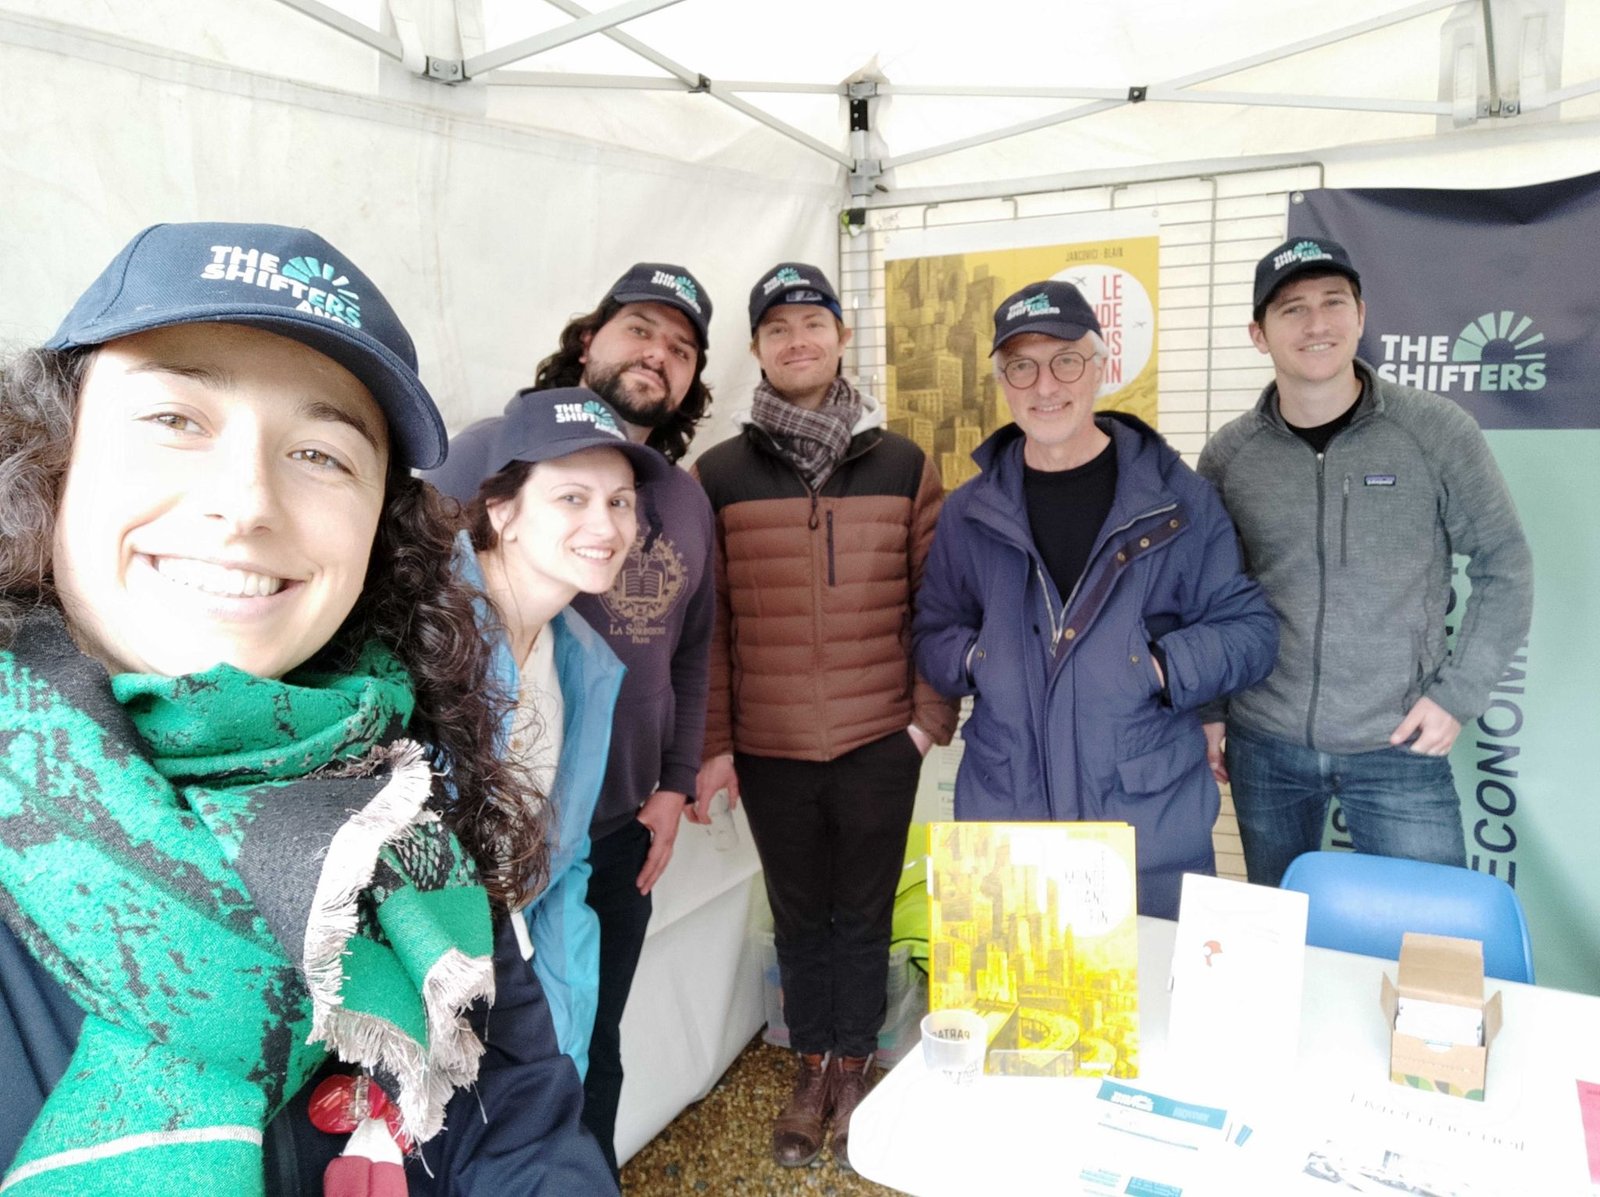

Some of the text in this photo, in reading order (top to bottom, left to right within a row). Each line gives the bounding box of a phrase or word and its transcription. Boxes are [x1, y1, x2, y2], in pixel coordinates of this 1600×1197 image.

[210, 246, 280, 274] THE
[654, 270, 676, 282] THE
[1102, 274, 1123, 301] LE
[200, 263, 362, 329] SHIFTERS
[1381, 335, 1449, 362] THE
[1377, 363, 1547, 392] SHIFTERS
[554, 403, 583, 414] THE
